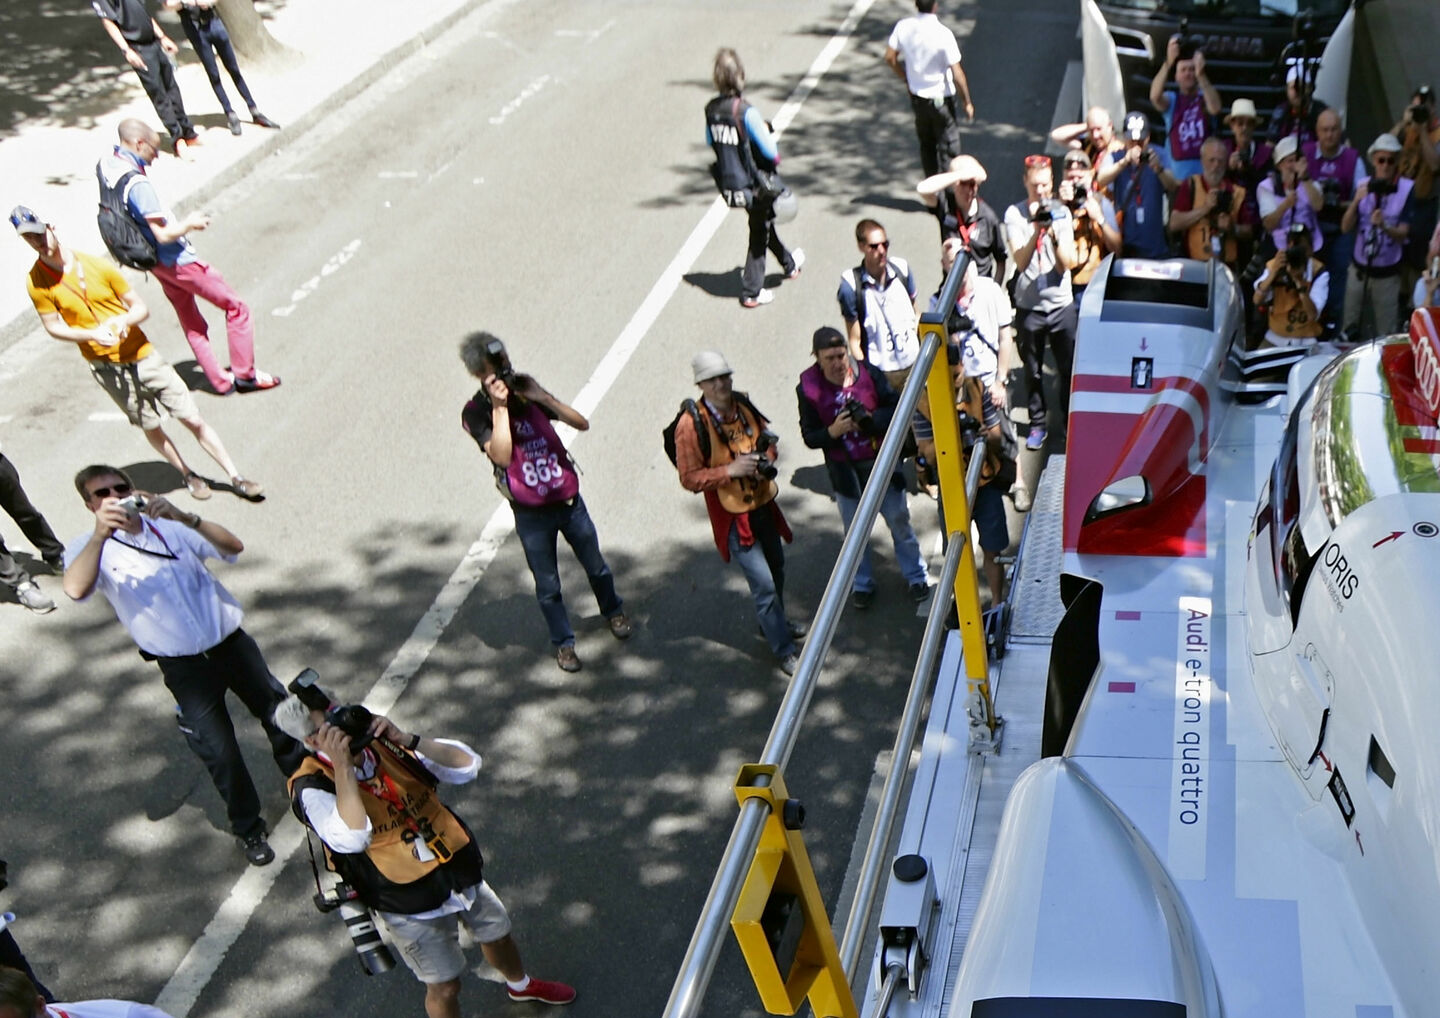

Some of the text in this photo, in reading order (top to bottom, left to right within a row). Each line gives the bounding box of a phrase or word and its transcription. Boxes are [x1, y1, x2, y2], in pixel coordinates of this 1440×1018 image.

[522, 453, 563, 486] 863
[1324, 543, 1359, 600] ORIS
[1177, 608, 1208, 825] Audi e-tron quattro
